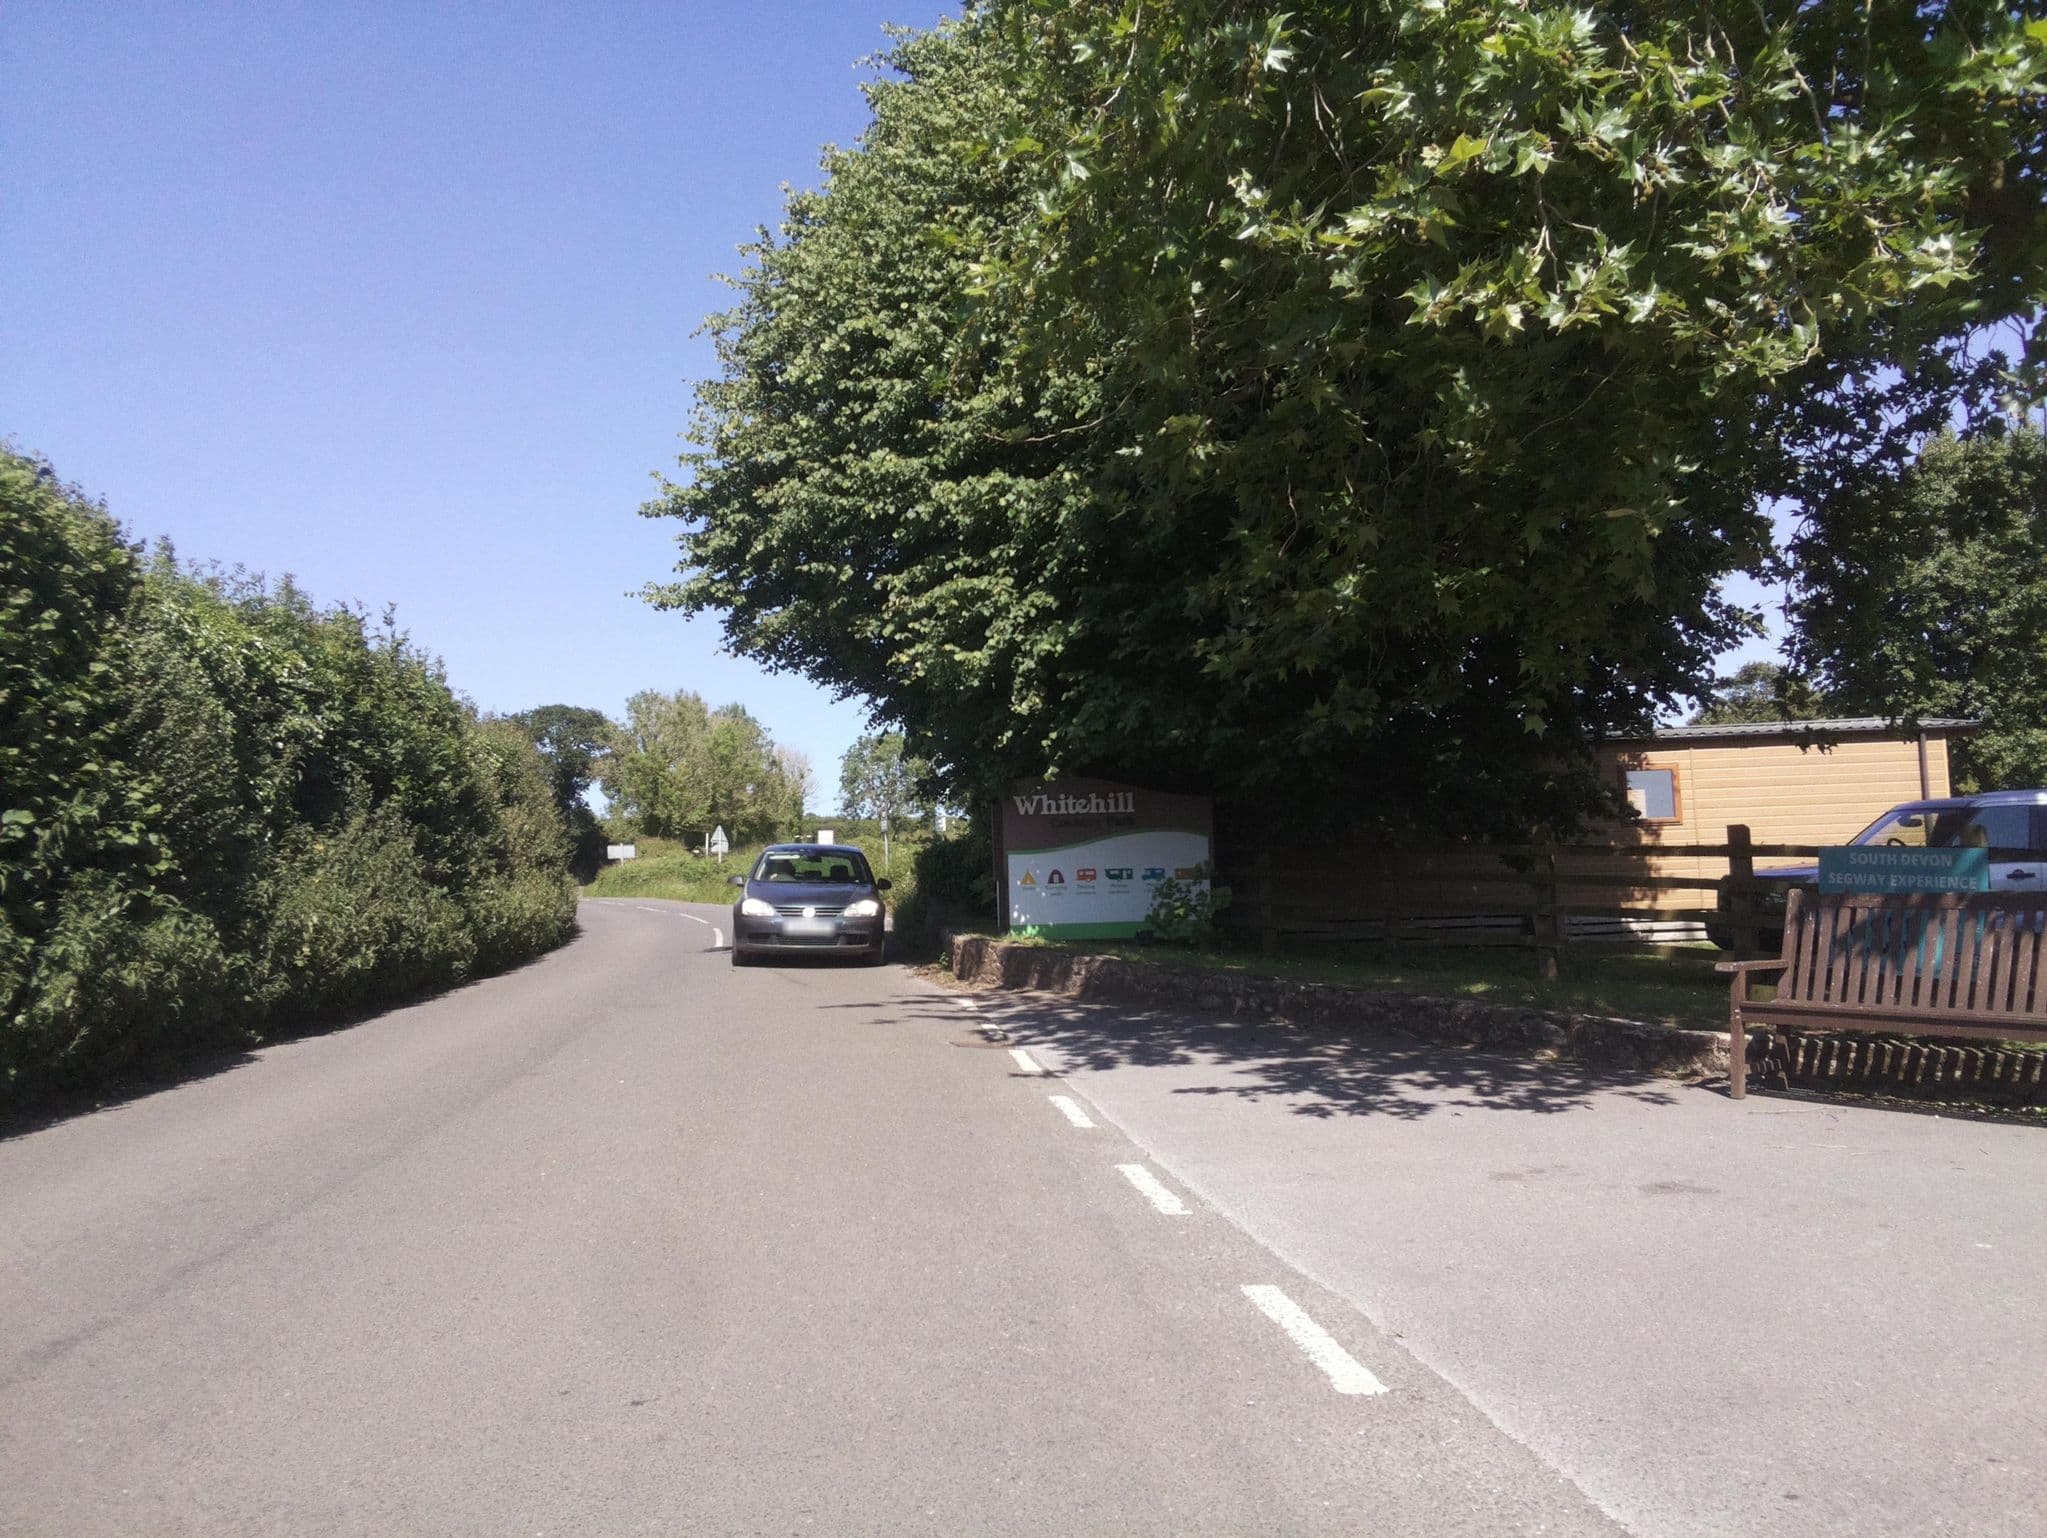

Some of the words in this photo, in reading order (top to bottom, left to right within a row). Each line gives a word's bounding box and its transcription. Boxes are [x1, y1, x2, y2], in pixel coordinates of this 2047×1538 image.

[1013, 792, 1135, 815] Whitehill
[1850, 852, 1897, 865] SOUTH
[1901, 853, 1953, 867] DEVON
[1829, 871, 1887, 887] SEGWAY
[1889, 874, 1977, 890] EXPERIENCE
